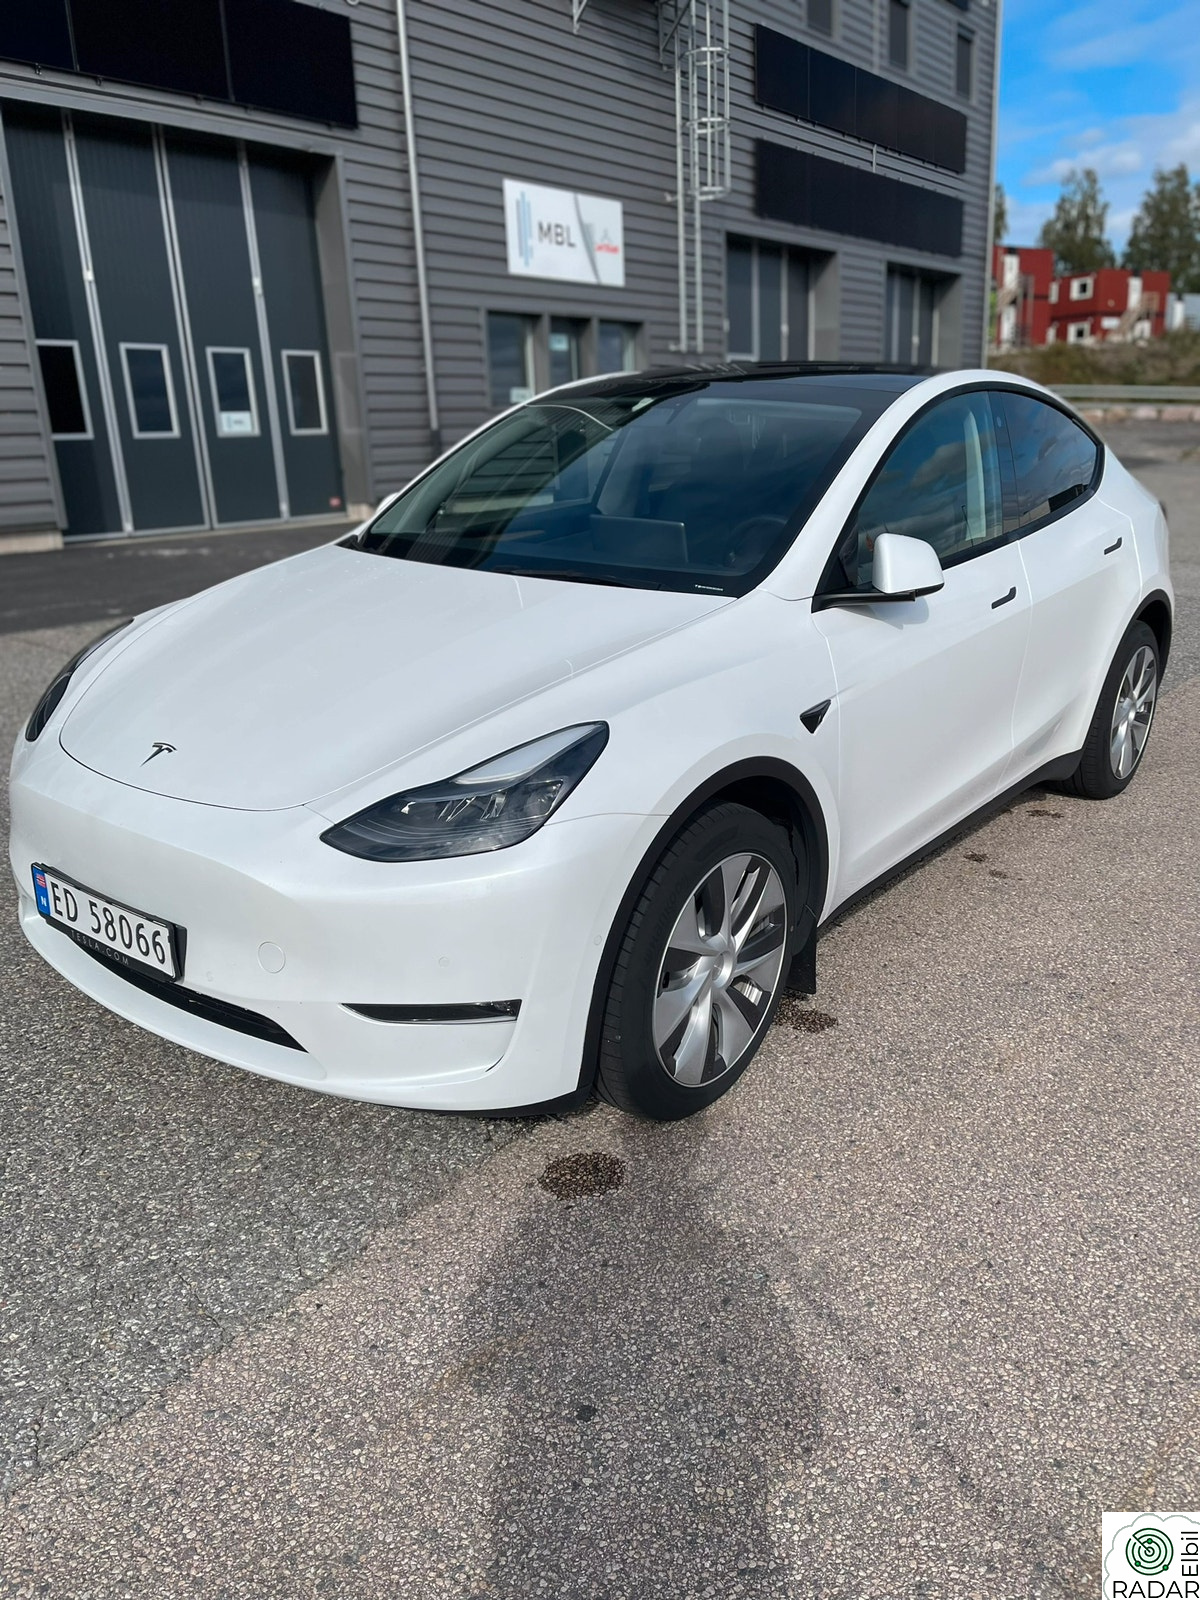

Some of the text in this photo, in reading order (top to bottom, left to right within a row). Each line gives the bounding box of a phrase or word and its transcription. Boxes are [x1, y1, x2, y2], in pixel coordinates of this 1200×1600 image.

[538, 221, 576, 248] MBL
[50, 880, 165, 965] ED 58066
[70, 929, 130, 966] TESLA.COM
